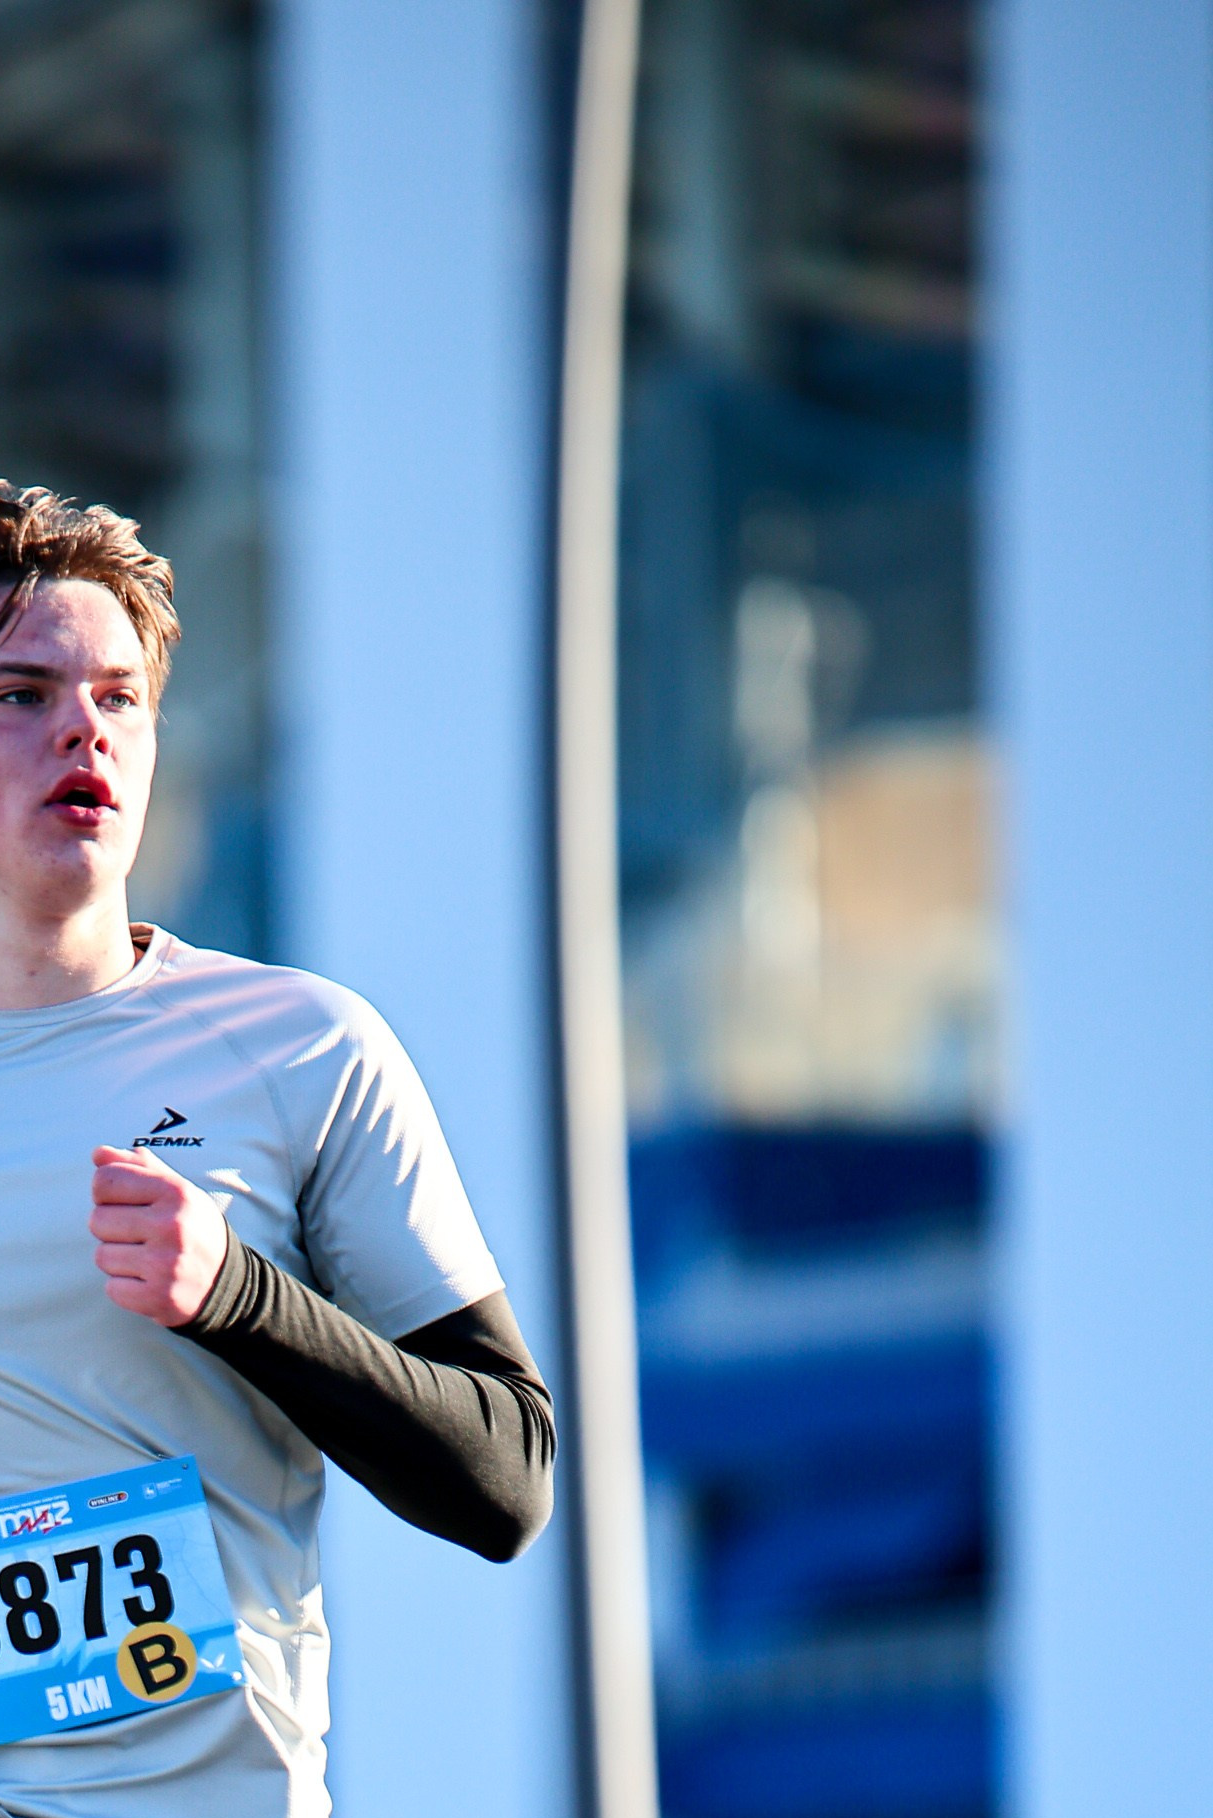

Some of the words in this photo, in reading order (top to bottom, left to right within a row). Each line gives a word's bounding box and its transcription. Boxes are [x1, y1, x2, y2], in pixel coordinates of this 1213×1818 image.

[132, 1136, 205, 1148] DEMIX
[128, 1633, 189, 1696] B
[45, 1684, 69, 1722] 5
[66, 1675, 113, 1717] KM
